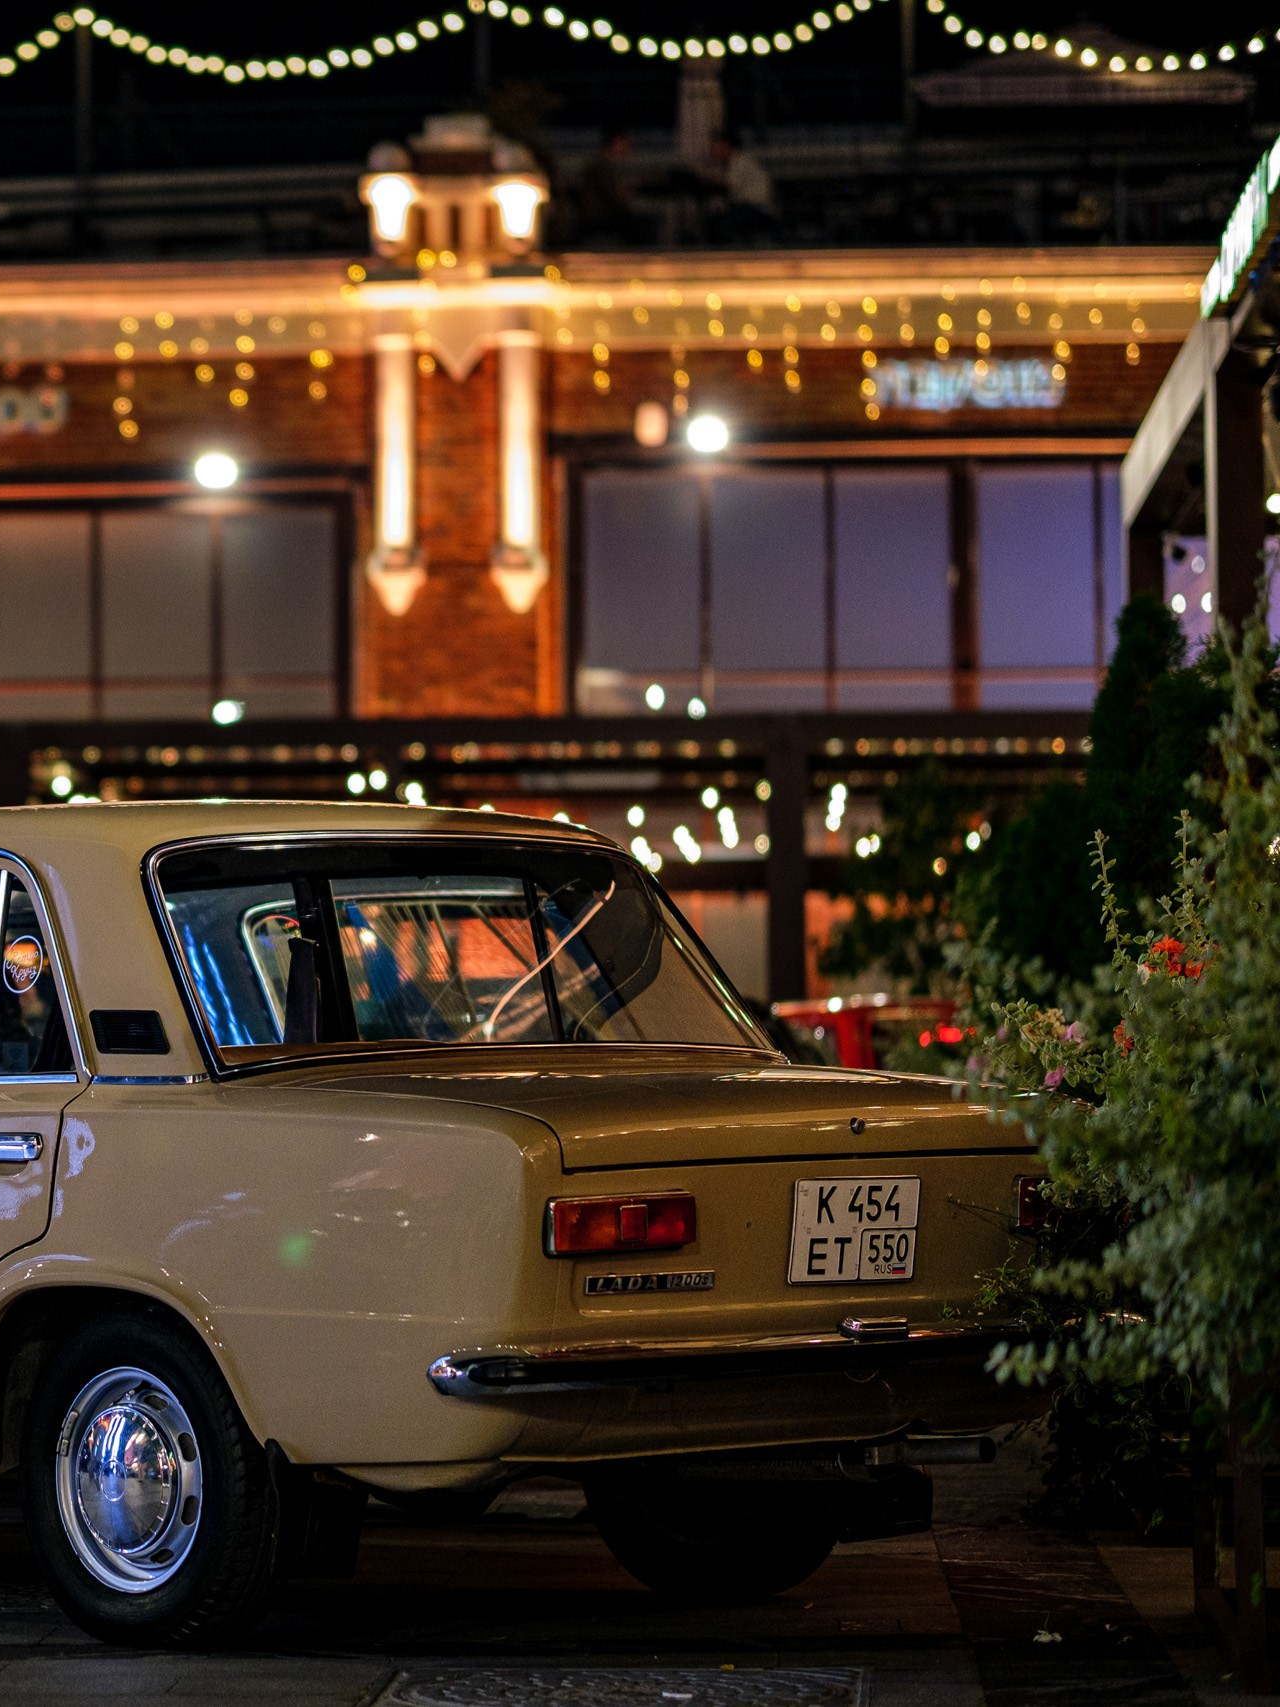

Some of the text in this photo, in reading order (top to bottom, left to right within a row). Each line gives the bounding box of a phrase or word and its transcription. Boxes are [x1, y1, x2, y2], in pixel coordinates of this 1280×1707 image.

[817, 1185, 900, 1224] K 454
[807, 1233, 909, 1276] ET 550
[874, 1264, 892, 1275] RUS
[596, 1276, 658, 1291] LADA
